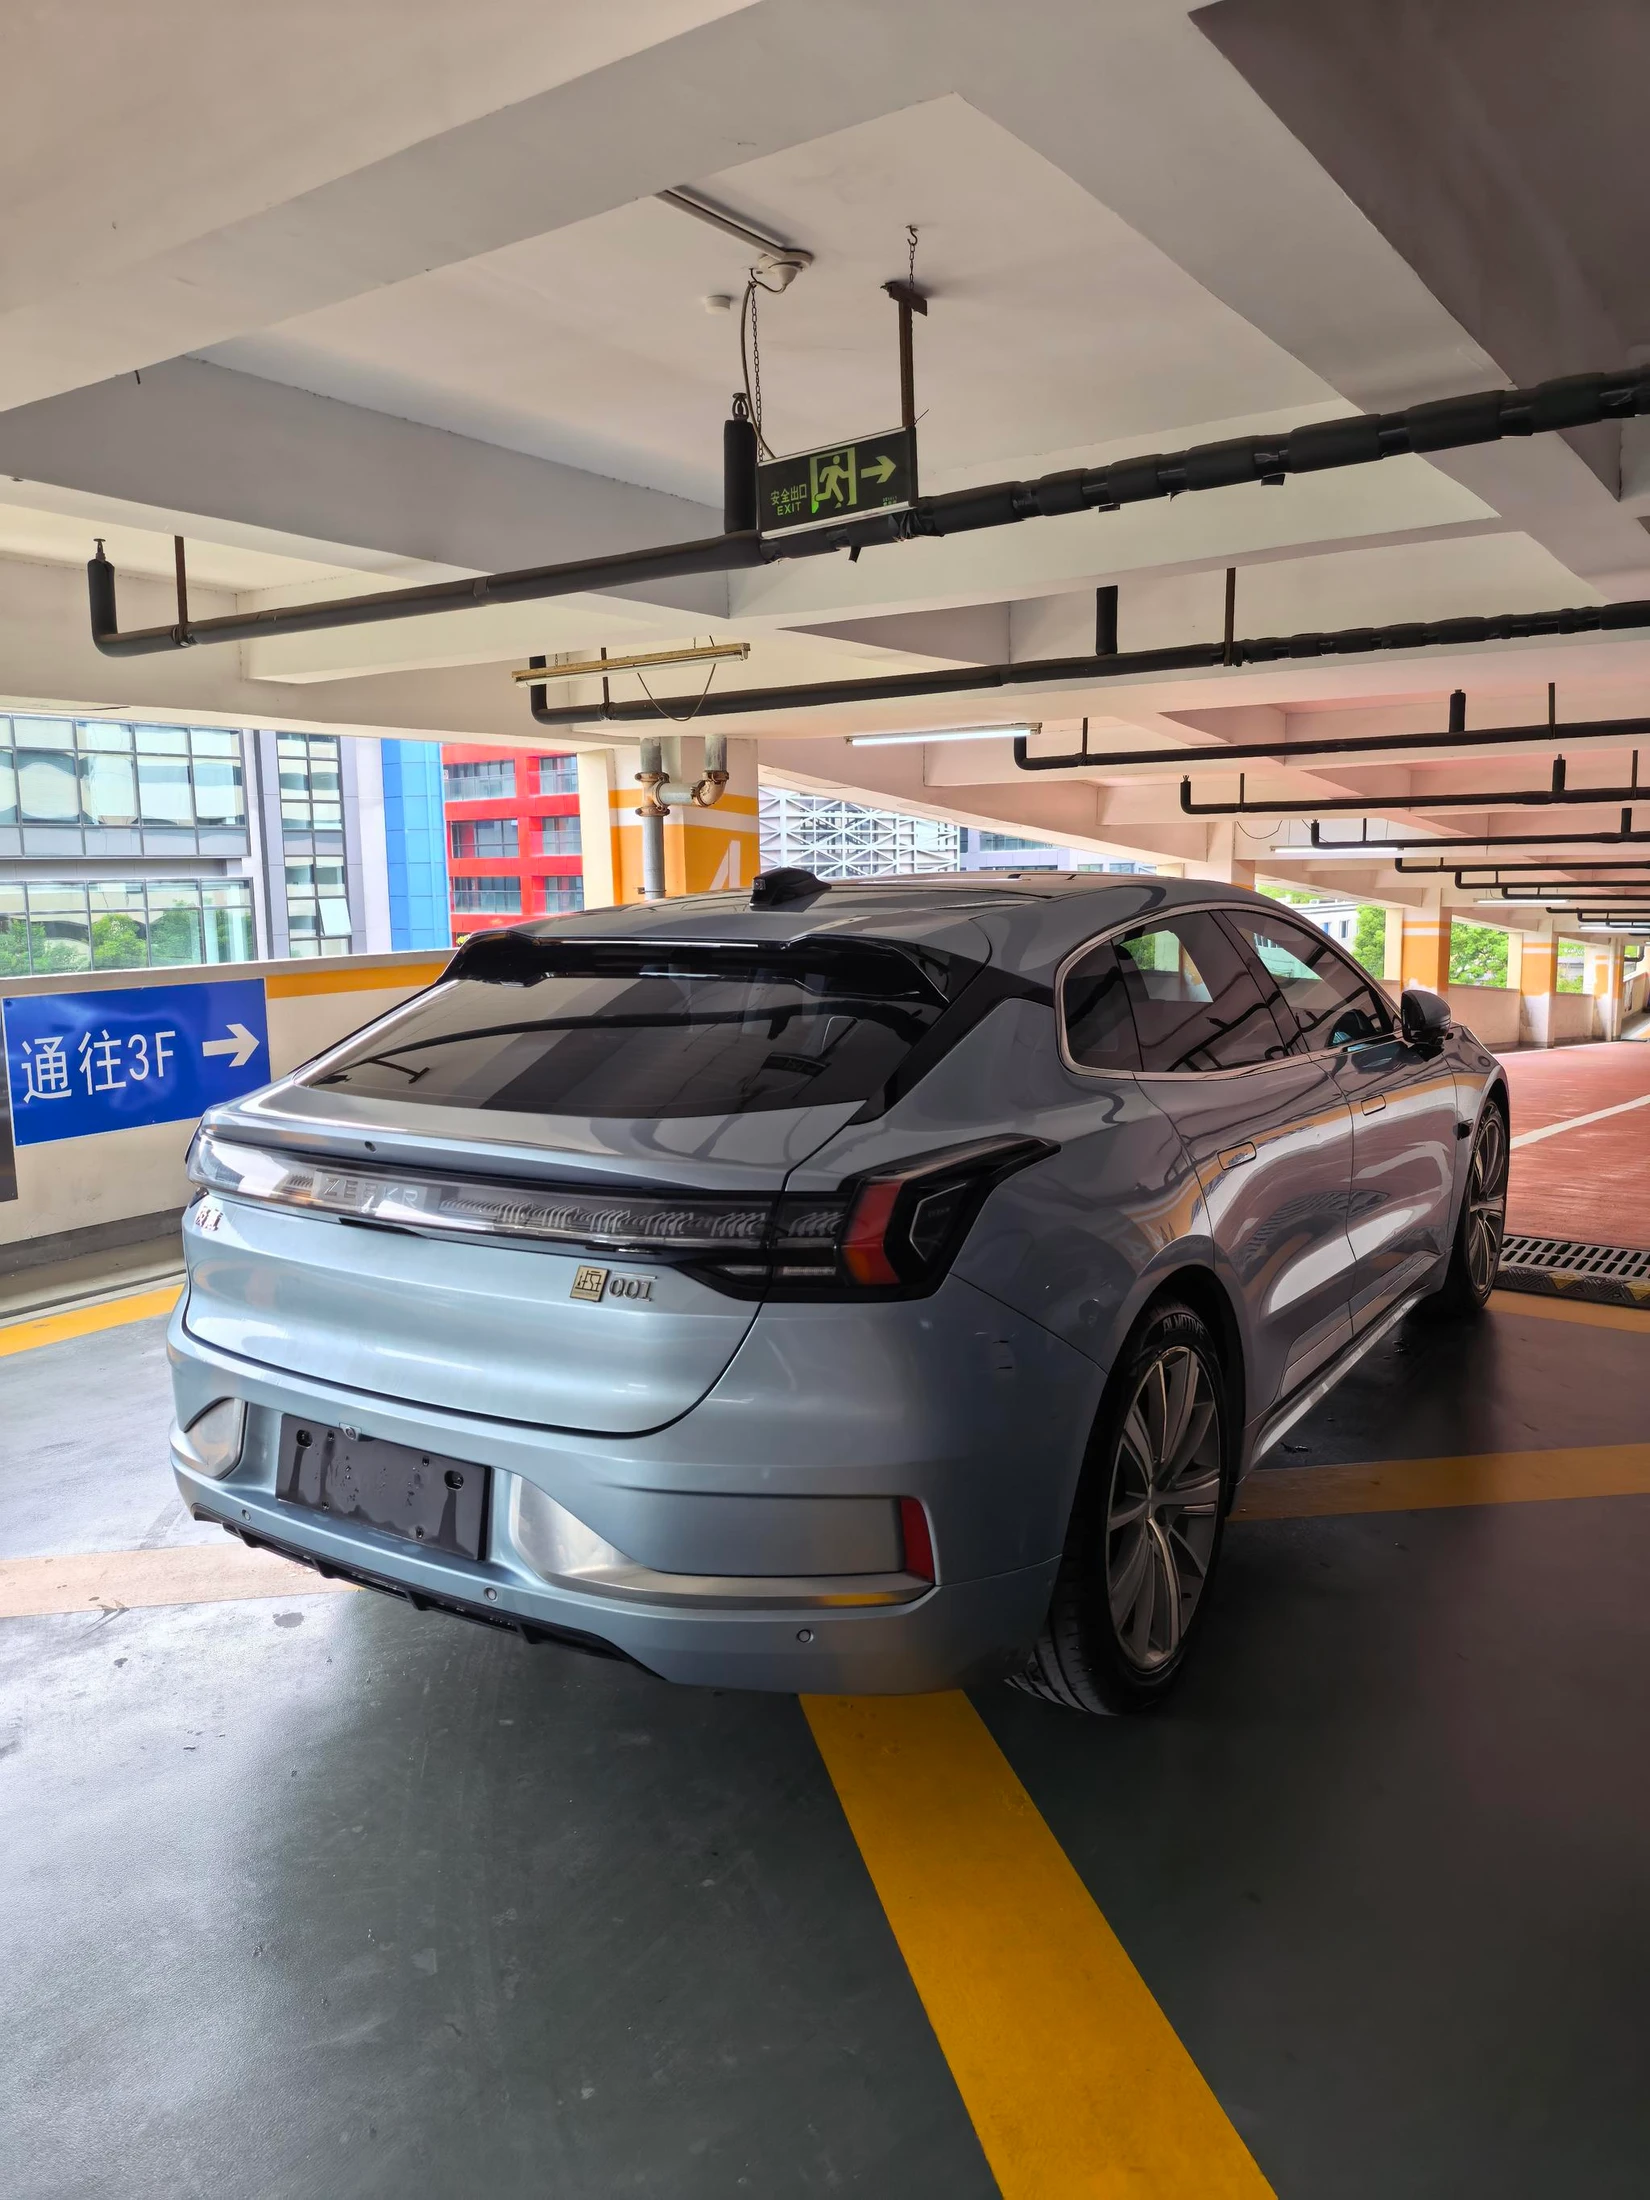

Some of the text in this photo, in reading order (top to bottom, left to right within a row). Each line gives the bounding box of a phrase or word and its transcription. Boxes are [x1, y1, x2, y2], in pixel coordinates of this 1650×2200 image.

[770, 483, 808, 506] 安全出口
[777, 501, 802, 516] EXIT
[20, 1029, 177, 1104] 通往3F
[324, 1176, 420, 1209] ZEEKR
[608, 1278, 652, 1302] 001
